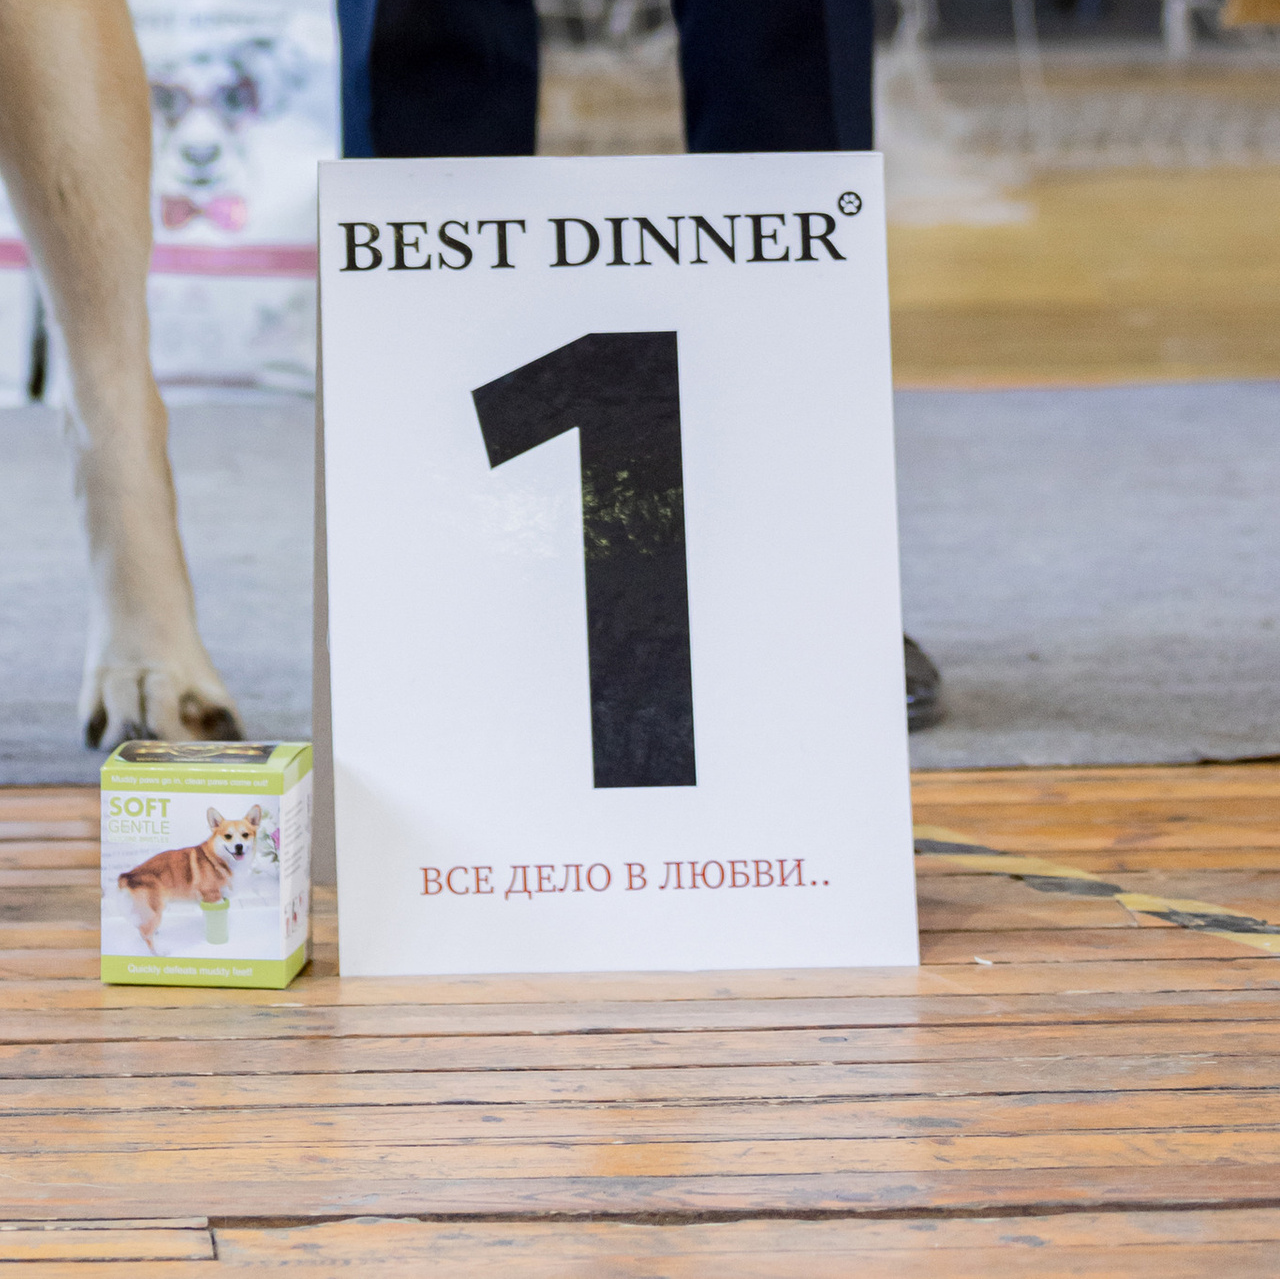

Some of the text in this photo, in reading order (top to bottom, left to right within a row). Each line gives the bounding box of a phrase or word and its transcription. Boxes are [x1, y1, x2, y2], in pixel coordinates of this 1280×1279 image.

[338, 210, 848, 272] BEST DINNER
[471, 330, 697, 789] 1
[110, 775, 137, 786] Muddy
[139, 777, 160, 786] paws
[162, 778, 172, 786] go
[184, 777, 206, 786] clean
[207, 778, 228, 787] paws
[230, 779, 252, 787] come
[109, 796, 171, 818] SOFT
[108, 819, 170, 835] GENTLE
[419, 865, 495, 896] ВСЕ
[504, 862, 612, 901] ДЕЛО
[624, 862, 648, 891] В
[127, 963, 160, 975] Quickly
[199, 966, 230, 977] muddy
